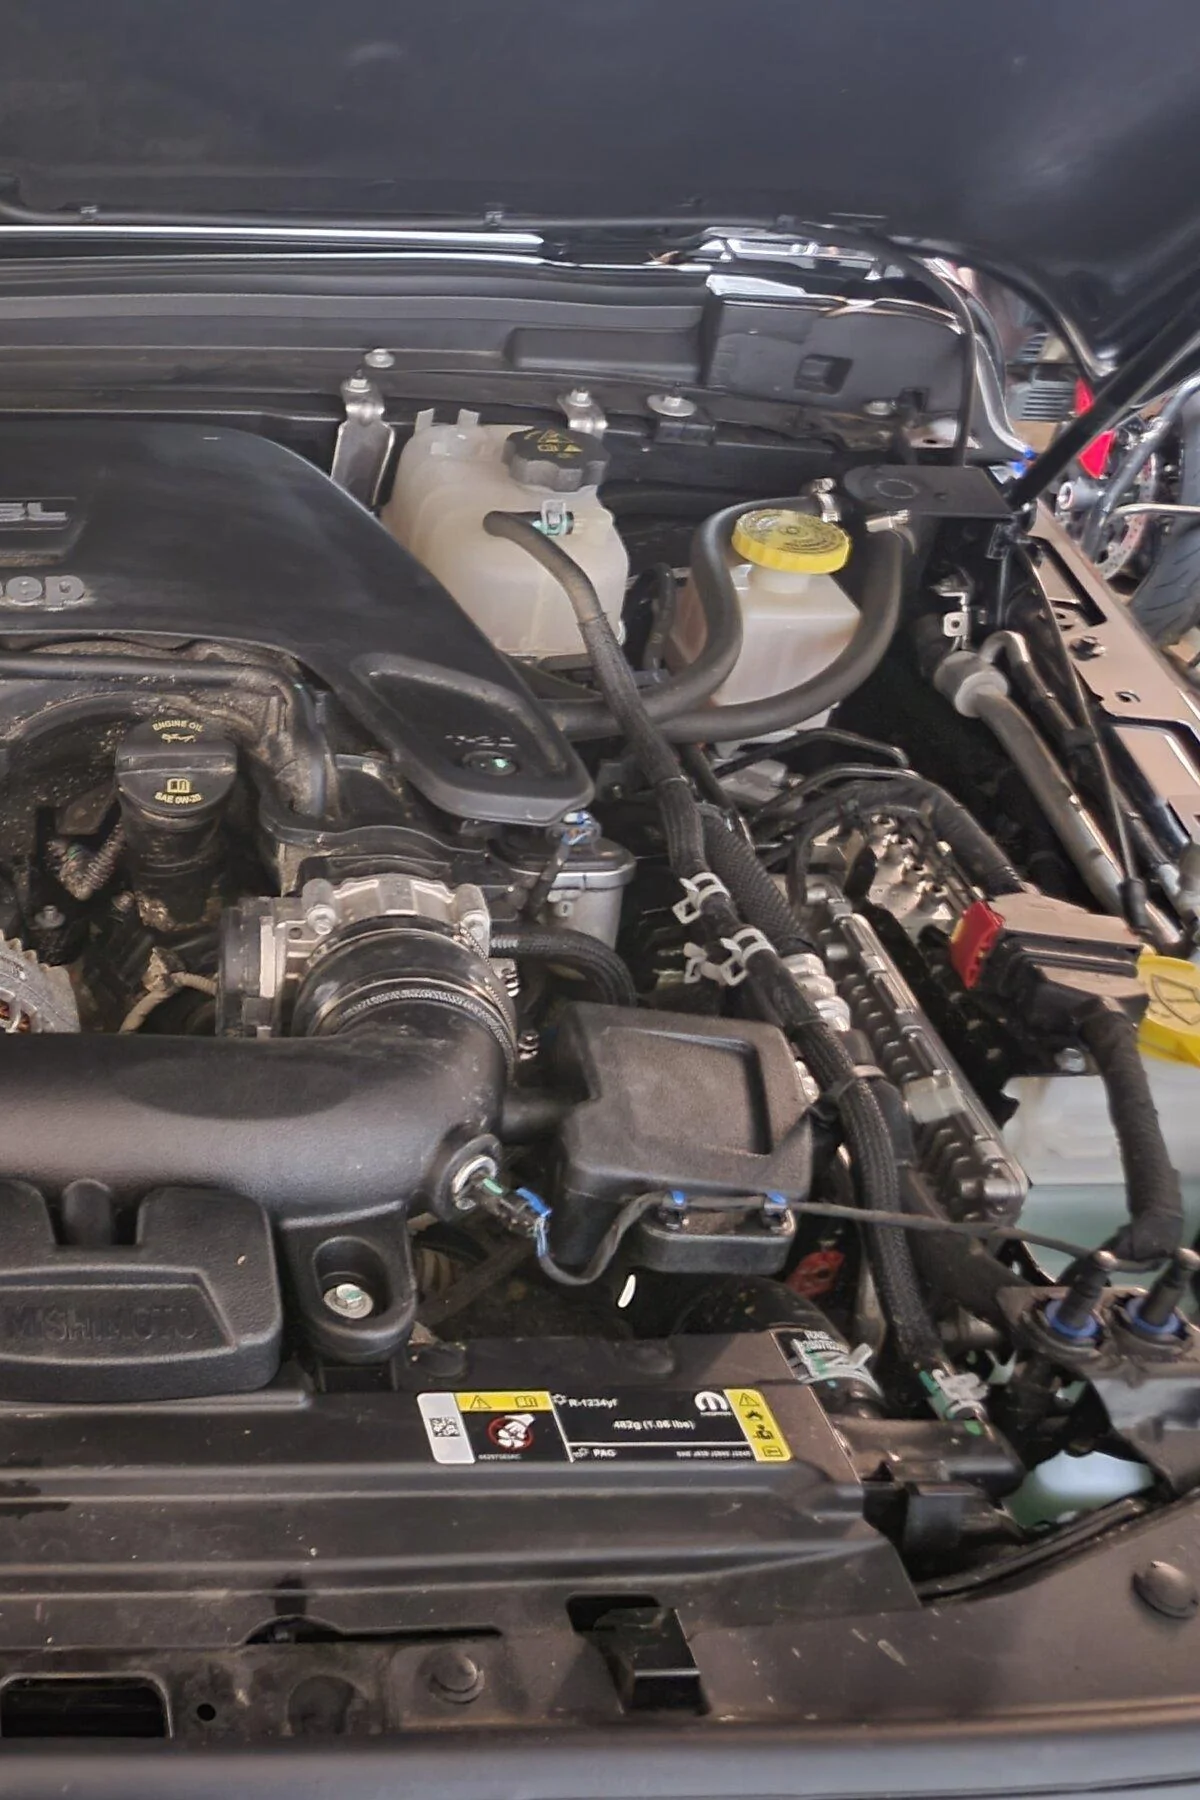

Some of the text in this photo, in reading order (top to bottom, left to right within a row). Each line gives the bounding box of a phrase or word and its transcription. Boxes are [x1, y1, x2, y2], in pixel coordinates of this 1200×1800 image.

[152, 720, 204, 732] ENGINE OIL
[155, 792, 174, 802] SAE
